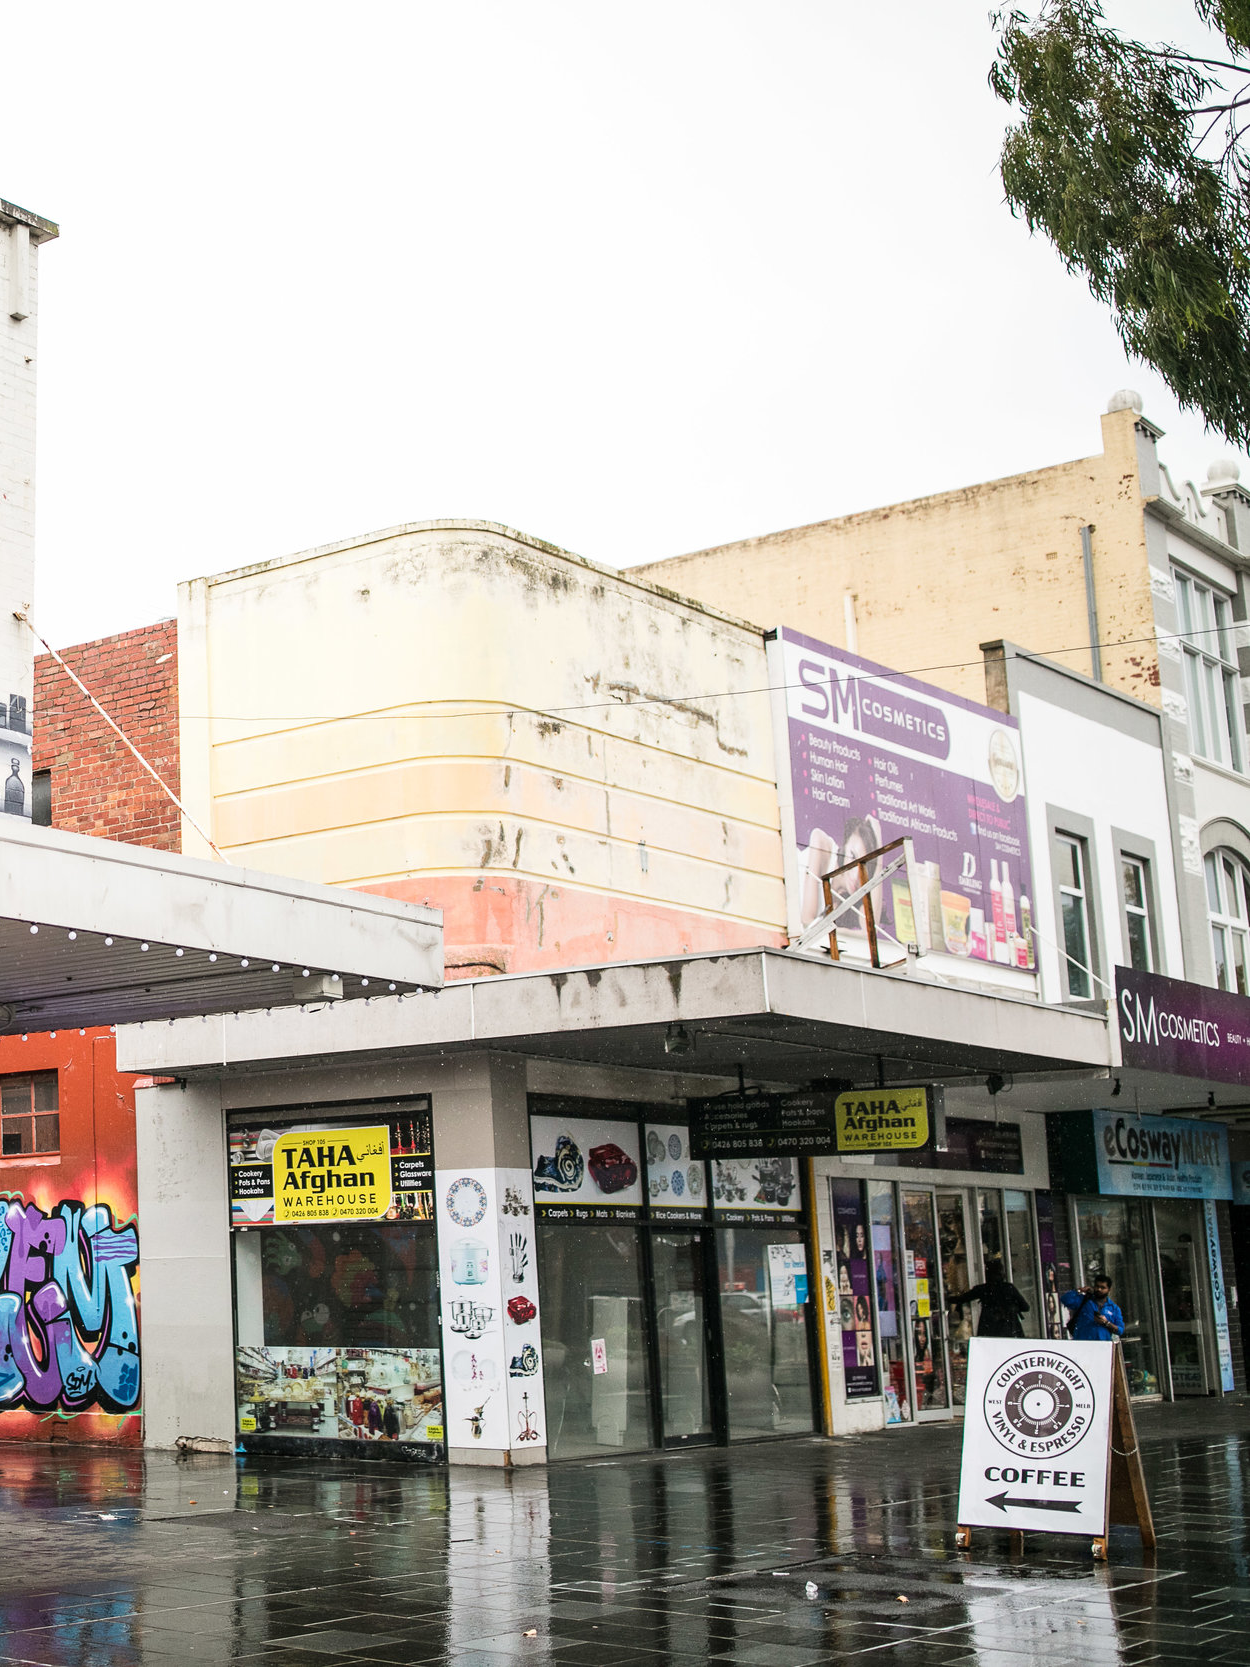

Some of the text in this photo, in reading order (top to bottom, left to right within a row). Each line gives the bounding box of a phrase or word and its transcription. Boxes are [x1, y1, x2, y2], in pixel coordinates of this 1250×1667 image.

[798, 659, 946, 742] SM COSMETICS
[808, 733, 861, 761] Beauty Products
[809, 751, 848, 774] Human Hair
[873, 757, 899, 776] Hair Oils
[810, 768, 845, 790] Skin Lotion
[874, 774, 904, 793] Perfumes
[812, 787, 851, 808] Hair Cream
[875, 790, 936, 820] Traditional Art Works
[877, 808, 958, 842] Traditional African Products
[962, 852, 976, 878] D
[1121, 988, 1159, 1047] SM
[1159, 1011, 1220, 1047] COSMETICS
[780, 1099, 814, 1108] Cookery
[842, 1100, 901, 1116] TAHA
[844, 1115, 916, 1132] Afghan
[712, 1141, 731, 1149] 0426
[732, 1140, 747, 1148] 805
[777, 1138, 798, 1146] 0470
[799, 1137, 814, 1145] 320
[816, 1136, 831, 1145] 004
[844, 1131, 918, 1141] WAREHOUSE
[1103, 1117, 1220, 1171] eCoswayMART
[282, 1145, 356, 1170] TAHA
[399, 1160, 425, 1169] Carpets
[238, 1170, 263, 1179] Cookery
[256, 1178, 271, 1186] Pans
[283, 1169, 375, 1194] Afghan
[400, 1170, 432, 1178] Glassware
[400, 1179, 422, 1187] Utilities
[239, 1187, 264, 1195] Hookahs
[283, 1193, 377, 1208] WAREHOUSE
[306, 1209, 317, 1217] 805
[339, 1208, 354, 1216] 0470
[367, 1207, 379, 1215] 004
[548, 1209, 636, 1219] Carpets Rugs Mats Blankets
[655, 1211, 666, 1220] Rice
[666, 1211, 685, 1220] Cookers
[690, 1212, 702, 1220] More
[726, 1213, 745, 1223] Cookery
[996, 1357, 1086, 1391] COUNTERWEIGHT
[992, 1411, 1086, 1453] VINYL & ESPRESSO
[984, 1466, 1086, 1488] COFFEE
